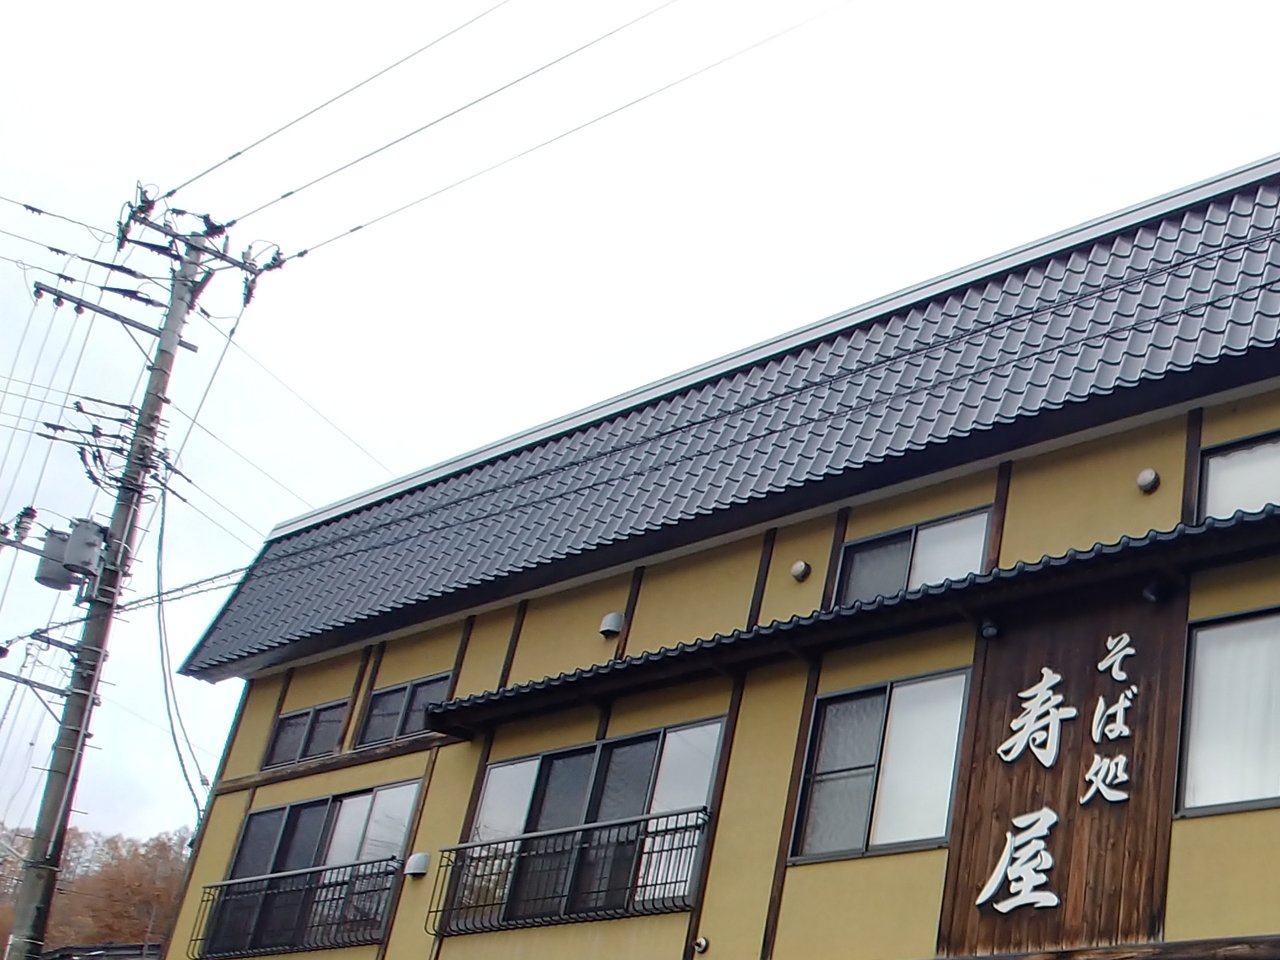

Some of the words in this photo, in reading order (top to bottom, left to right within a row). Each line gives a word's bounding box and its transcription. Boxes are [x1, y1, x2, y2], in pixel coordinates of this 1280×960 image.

[976, 666, 1078, 915] 寿屋
[1080, 632, 1138, 806] そば処
